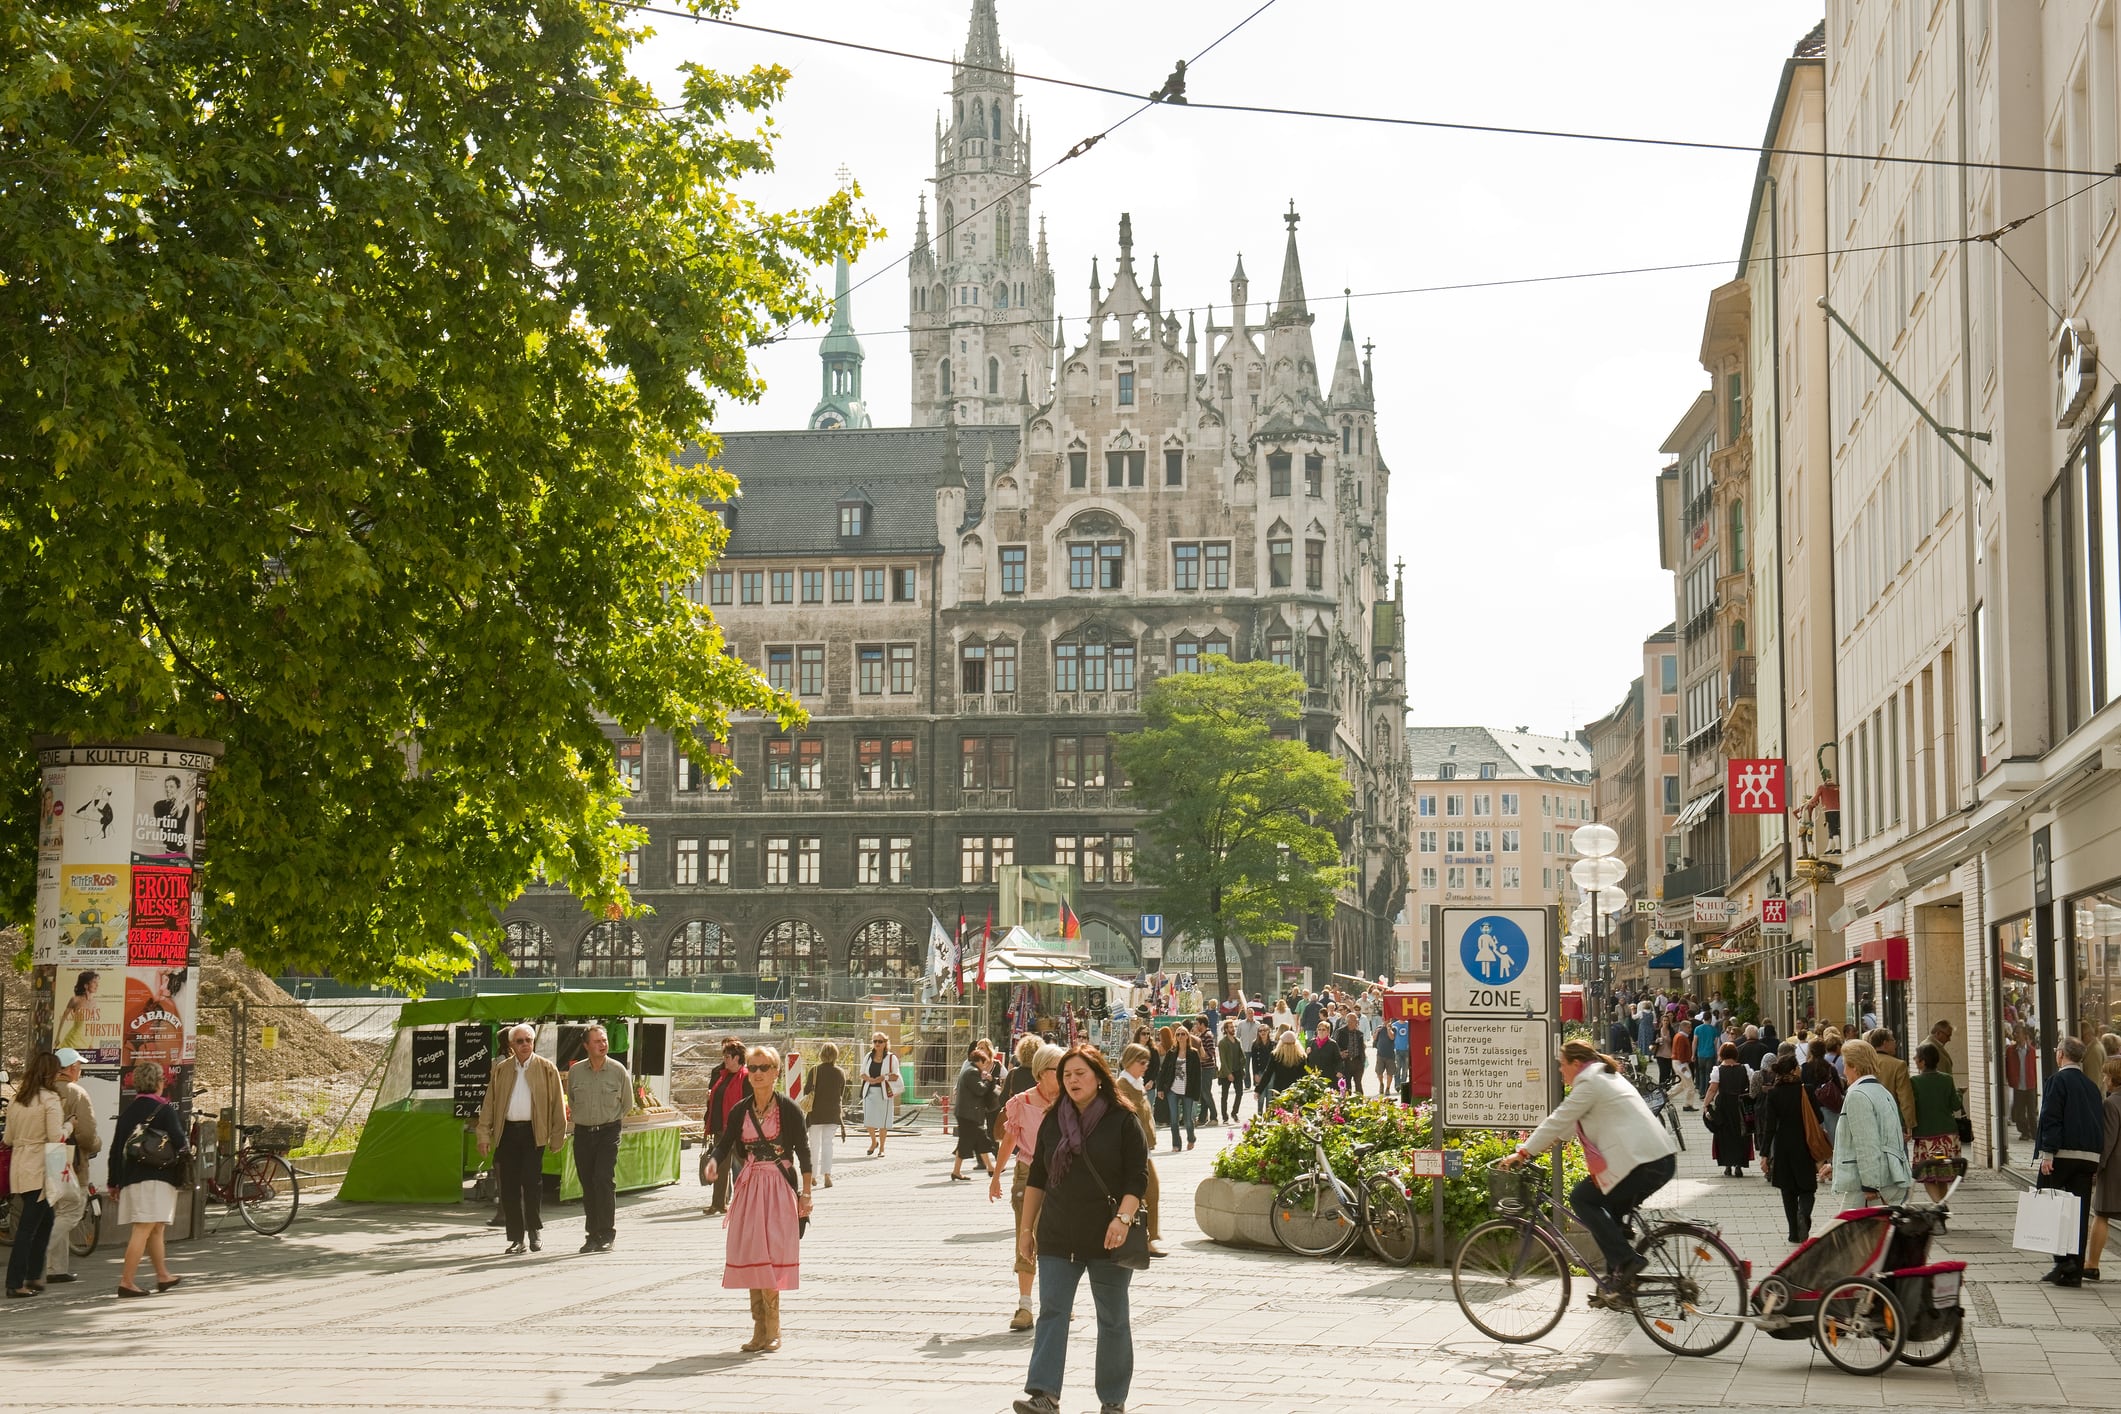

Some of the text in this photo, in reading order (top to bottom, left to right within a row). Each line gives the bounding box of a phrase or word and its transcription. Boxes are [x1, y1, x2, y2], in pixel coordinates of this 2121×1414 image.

[86, 750, 149, 764] KULTUR
[179, 754, 211, 769] SZENE
[136, 814, 178, 829] Martin
[135, 827, 192, 847] Grubinger
[135, 875, 189, 899] EROTIK
[135, 898, 178, 916] MESSE
[1696, 911, 1725, 921] KLEIN
[1144, 916, 1160, 934] U
[130, 945, 187, 959] OLYMPIAPARK
[1469, 990, 1521, 1007] ZONE
[130, 1010, 182, 1030] CABARET
[1447, 1024, 1524, 1033] Lieferverkehr für
[1447, 1035, 1492, 1045] Fahrzeuge
[416, 1049, 445, 1066] Feigen
[458, 1045, 488, 1069] Spargel
[1447, 1046, 1461, 1054] bis
[1482, 1046, 1528, 1056] zulässiges
[1448, 1057, 1532, 1067] Gesamtgewicht frei
[1462, 1068, 1508, 1078] Werktagen
[1448, 1079, 1460, 1087] bis
[1463, 1079, 1484, 1087] 10.15
[1506, 1080, 1522, 1088] und
[1448, 1090, 1458, 1098] ab
[1462, 1090, 1484, 1098] 22.30
[455, 1104, 463, 1116] 2
[1499, 1102, 1545, 1112] Feiertagen
[1449, 1112, 1479, 1122] jeweils
[1523, 1113, 1539, 1121] Uhr
